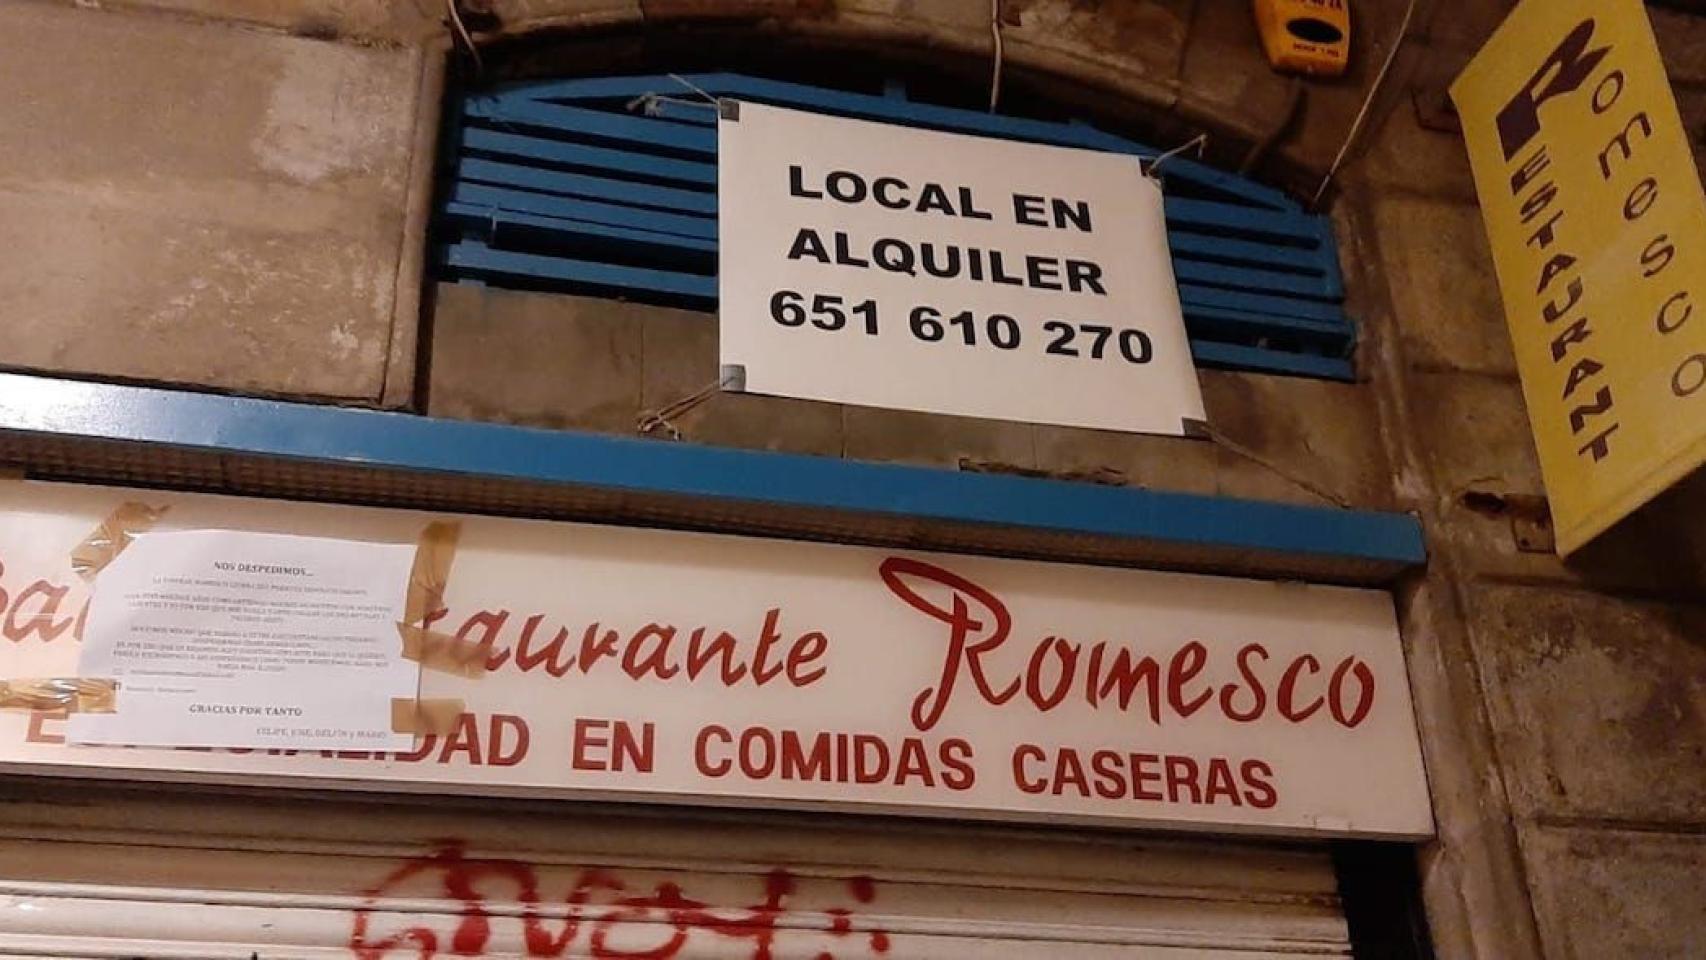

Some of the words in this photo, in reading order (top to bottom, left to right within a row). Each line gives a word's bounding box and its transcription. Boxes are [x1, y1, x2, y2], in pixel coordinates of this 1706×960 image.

[788, 165, 993, 221] LOCAL
[1011, 192, 1094, 233] EN
[787, 227, 1108, 296] ALQUILER
[769, 290, 879, 336] 651
[908, 305, 1022, 351] 610
[1042, 320, 1153, 365] 270
[879, 556, 1376, 732] Romesco
[264, 706, 303, 717] TANTO
[571, 717, 656, 774] EN
[694, 724, 976, 791] COMIDAS
[1012, 743, 1279, 811] CASERAS
